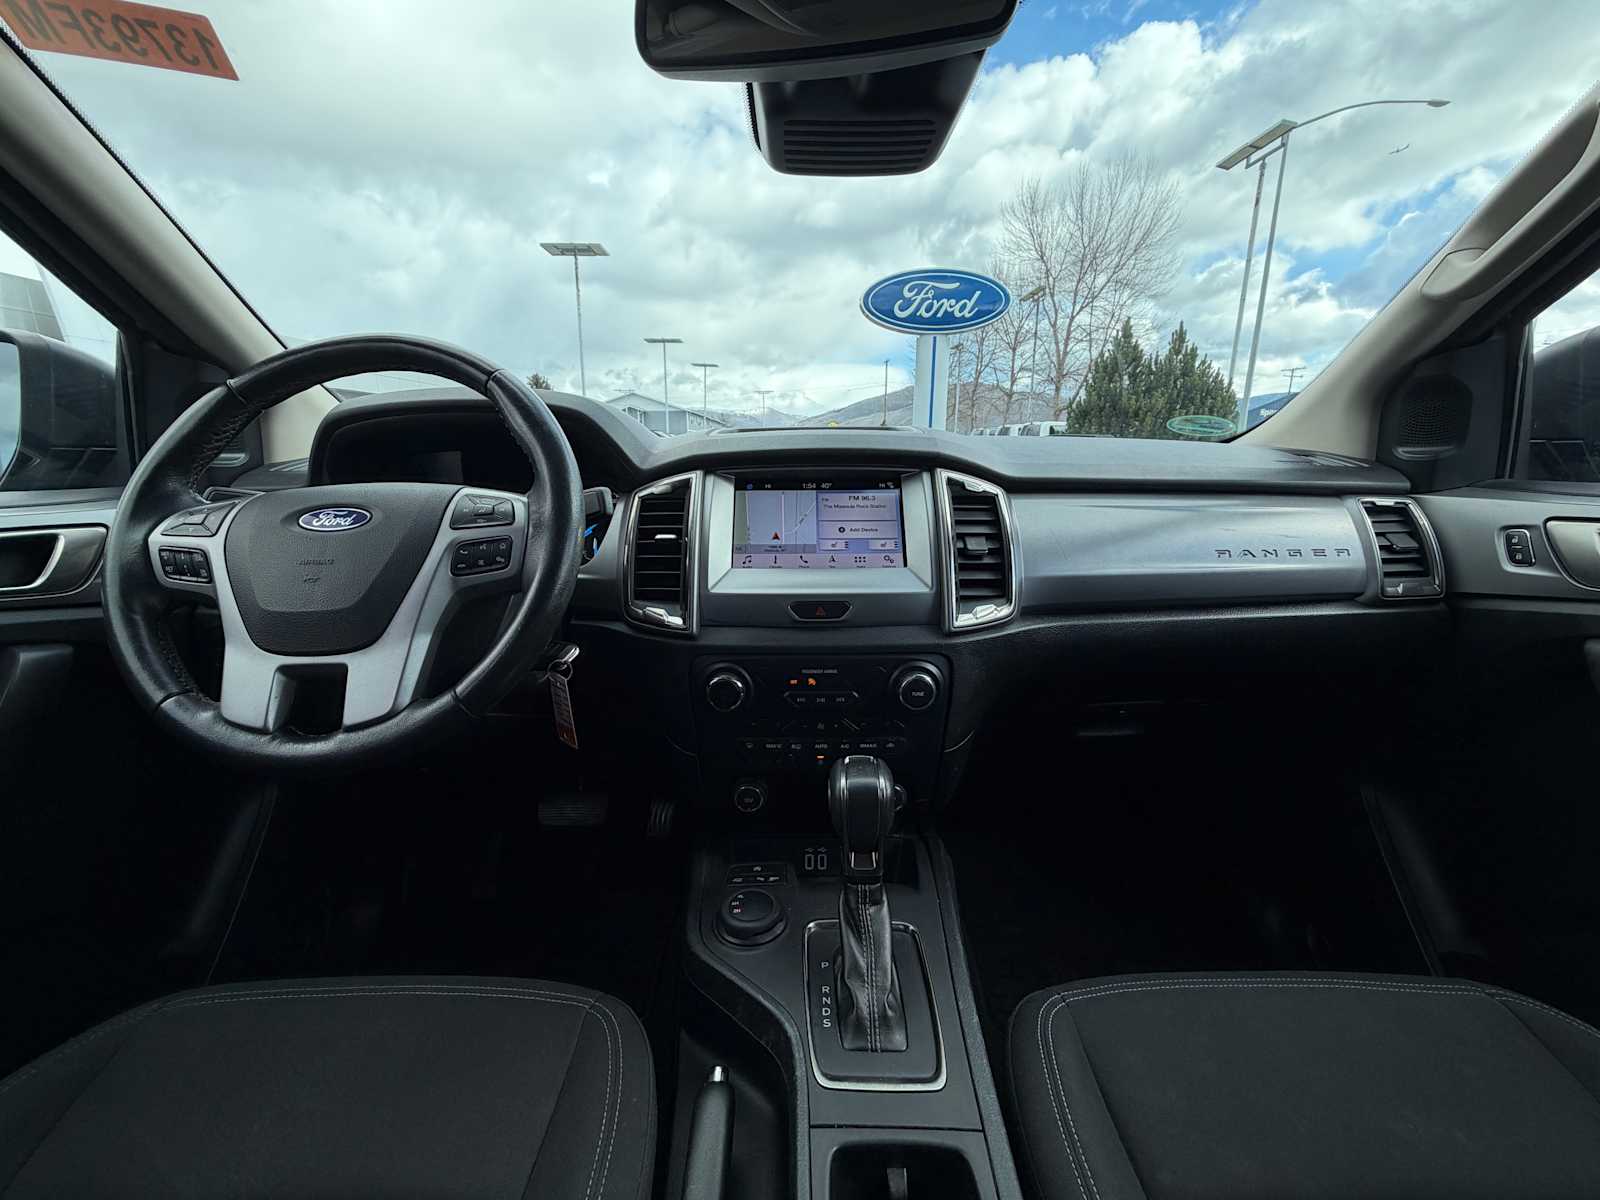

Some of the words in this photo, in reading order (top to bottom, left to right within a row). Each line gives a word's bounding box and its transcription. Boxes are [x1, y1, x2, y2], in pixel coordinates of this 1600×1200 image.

[893, 280, 982, 318] Ford
[313, 511, 357, 526] Ford
[1214, 548, 1351, 558] RANGER
[822, 985, 830, 994] R
[822, 997, 831, 1005] N
[822, 1007, 831, 1016] D
[823, 1018, 832, 1028] S
